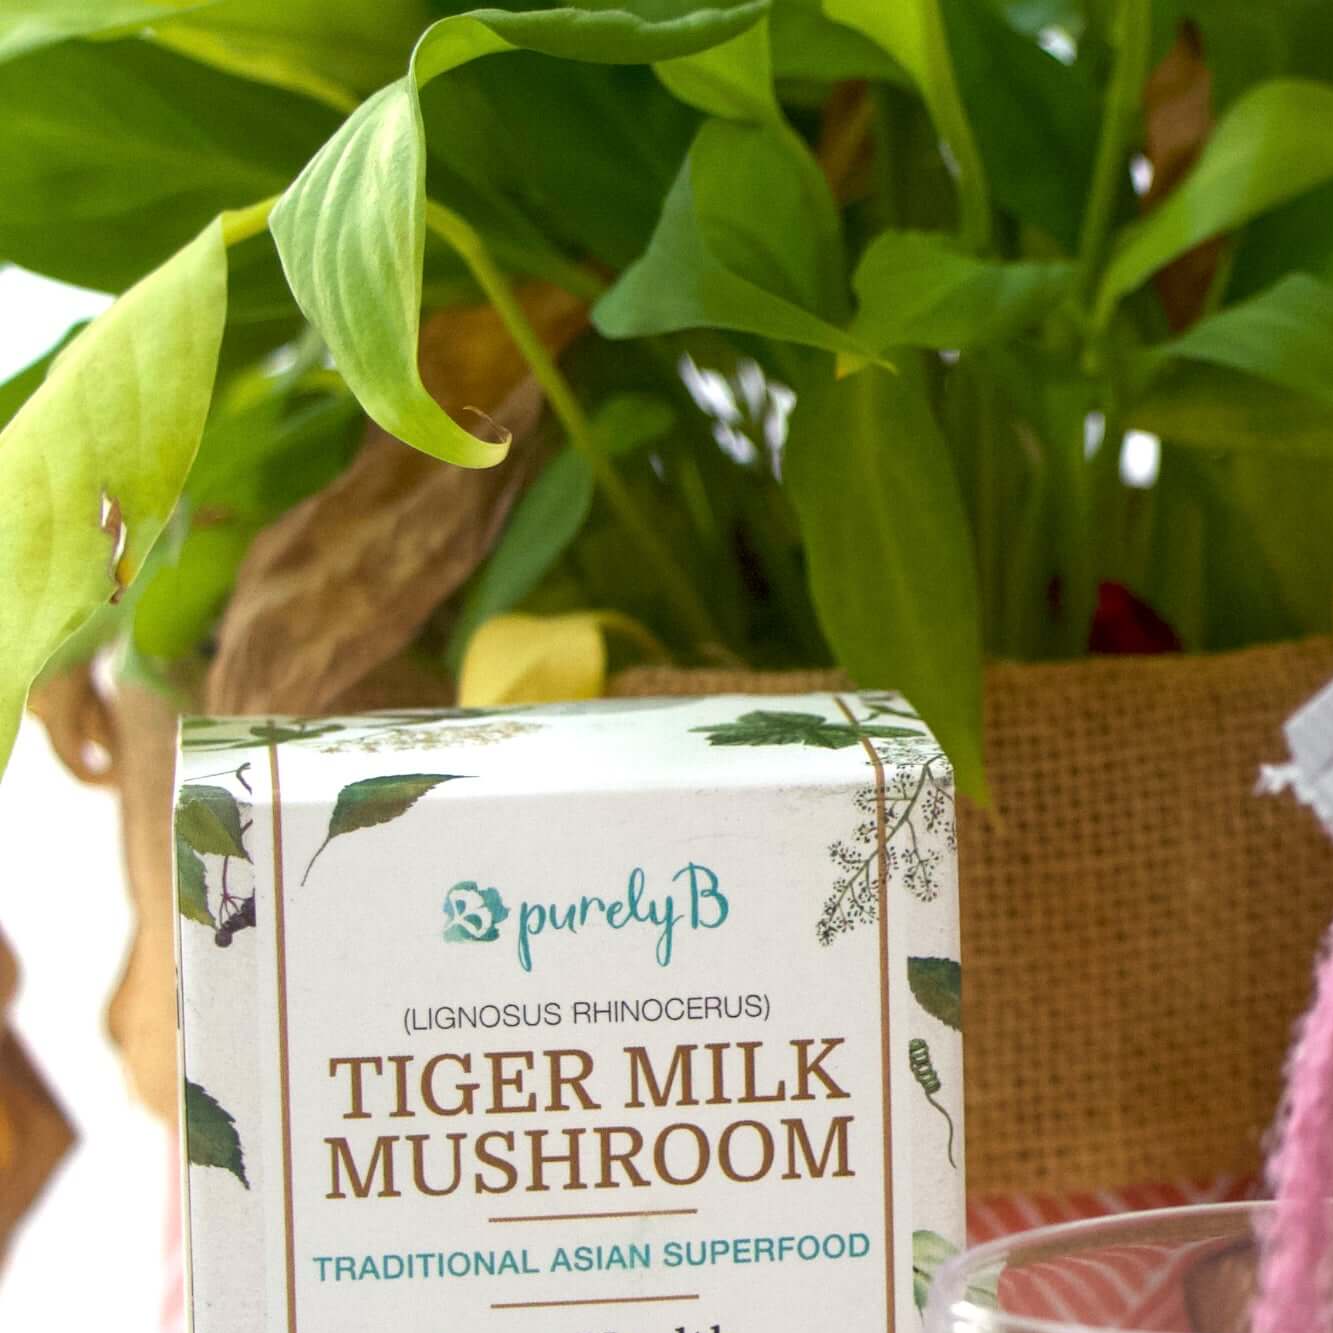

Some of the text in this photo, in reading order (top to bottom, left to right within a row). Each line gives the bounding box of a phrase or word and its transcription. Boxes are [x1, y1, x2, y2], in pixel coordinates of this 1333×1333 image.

[403, 993, 771, 1036] (LIGNOSUS RHINOCERUS)
[328, 1036, 852, 1120] TIGER MILK
[323, 1114, 856, 1200] MUSHROOM
[312, 1232, 871, 1282] TRADITIONAL ASIAN SUPERFOOD
